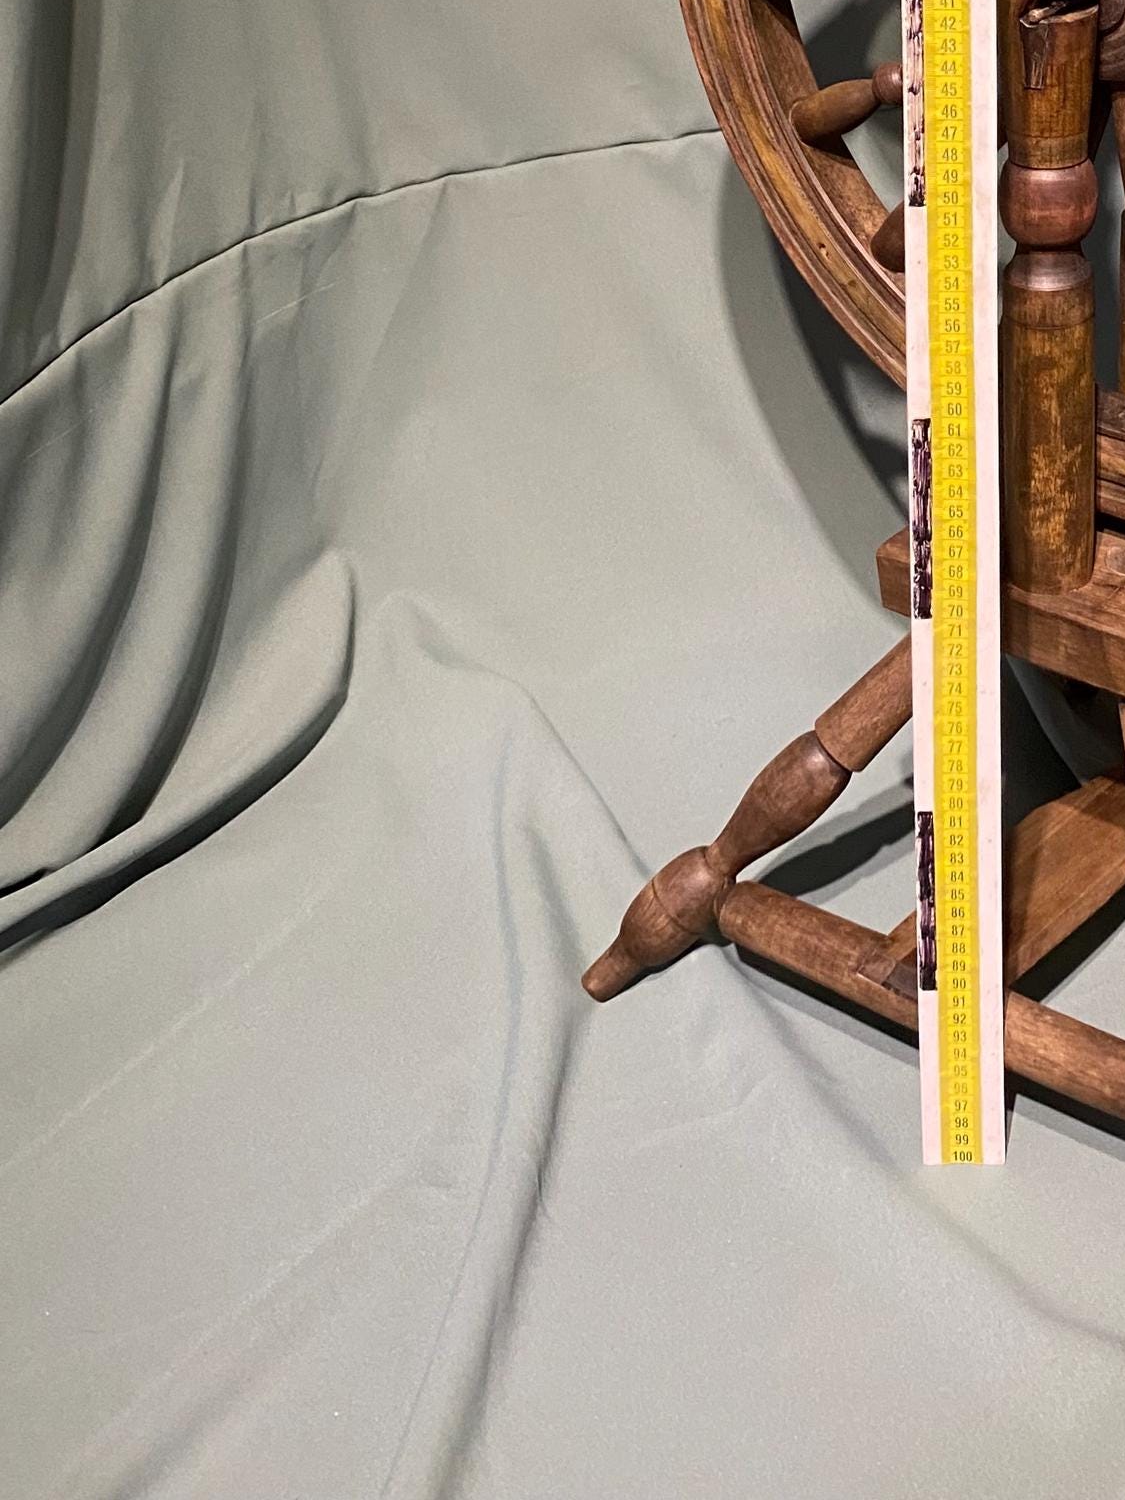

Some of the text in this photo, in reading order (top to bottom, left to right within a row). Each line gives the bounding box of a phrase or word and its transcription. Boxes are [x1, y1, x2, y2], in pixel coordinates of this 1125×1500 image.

[939, 15, 957, 31] 42
[939, 37, 957, 53] 43
[940, 59, 957, 75] 44
[941, 81, 958, 97] 45
[941, 104, 958, 119] 46
[941, 125, 958, 141] 47
[941, 147, 958, 163] 48
[942, 169, 959, 184] 49
[943, 190, 959, 205] 50
[943, 211, 958, 227] 51
[943, 233, 960, 248] 52
[943, 254, 960, 270] 53
[943, 276, 960, 291] 54
[944, 297, 960, 312] 55
[944, 318, 961, 333] 56
[944, 339, 961, 354] 57
[945, 360, 962, 375] 58
[946, 381, 962, 396] 59
[947, 402, 963, 417] 60
[947, 423, 961, 437] 61
[947, 443, 963, 458] 62
[947, 463, 964, 478] 63
[948, 484, 963, 499] 64
[948, 504, 964, 519] 65
[948, 525, 964, 539] 66
[948, 545, 964, 559] 67
[948, 564, 964, 579] 68
[948, 584, 963, 599] 69
[948, 604, 964, 618] 70
[948, 623, 962, 637] 71
[947, 643, 963, 657] 72
[947, 662, 963, 676] 73
[948, 682, 962, 696] 74
[947, 700, 963, 714] 75
[947, 720, 963, 734] 76
[947, 739, 963, 754] 77
[947, 759, 964, 772] 78
[948, 778, 964, 792] 79
[948, 797, 964, 811] 80
[949, 816, 962, 828] 81
[949, 834, 964, 846] 82
[949, 852, 964, 865] 83
[950, 870, 964, 883] 84
[950, 888, 965, 901] 85
[951, 907, 965, 919] 86
[951, 924, 965, 936] 87
[951, 942, 966, 954] 88
[952, 959, 966, 972] 89
[952, 977, 967, 990] 90
[952, 995, 965, 1008] 91
[952, 1012, 967, 1025] 92
[952, 1029, 967, 1043] 93
[954, 1099, 968, 1112] 97
[954, 1116, 969, 1129] 98
[955, 1133, 969, 1145] 99
[953, 1150, 973, 1163] 100
